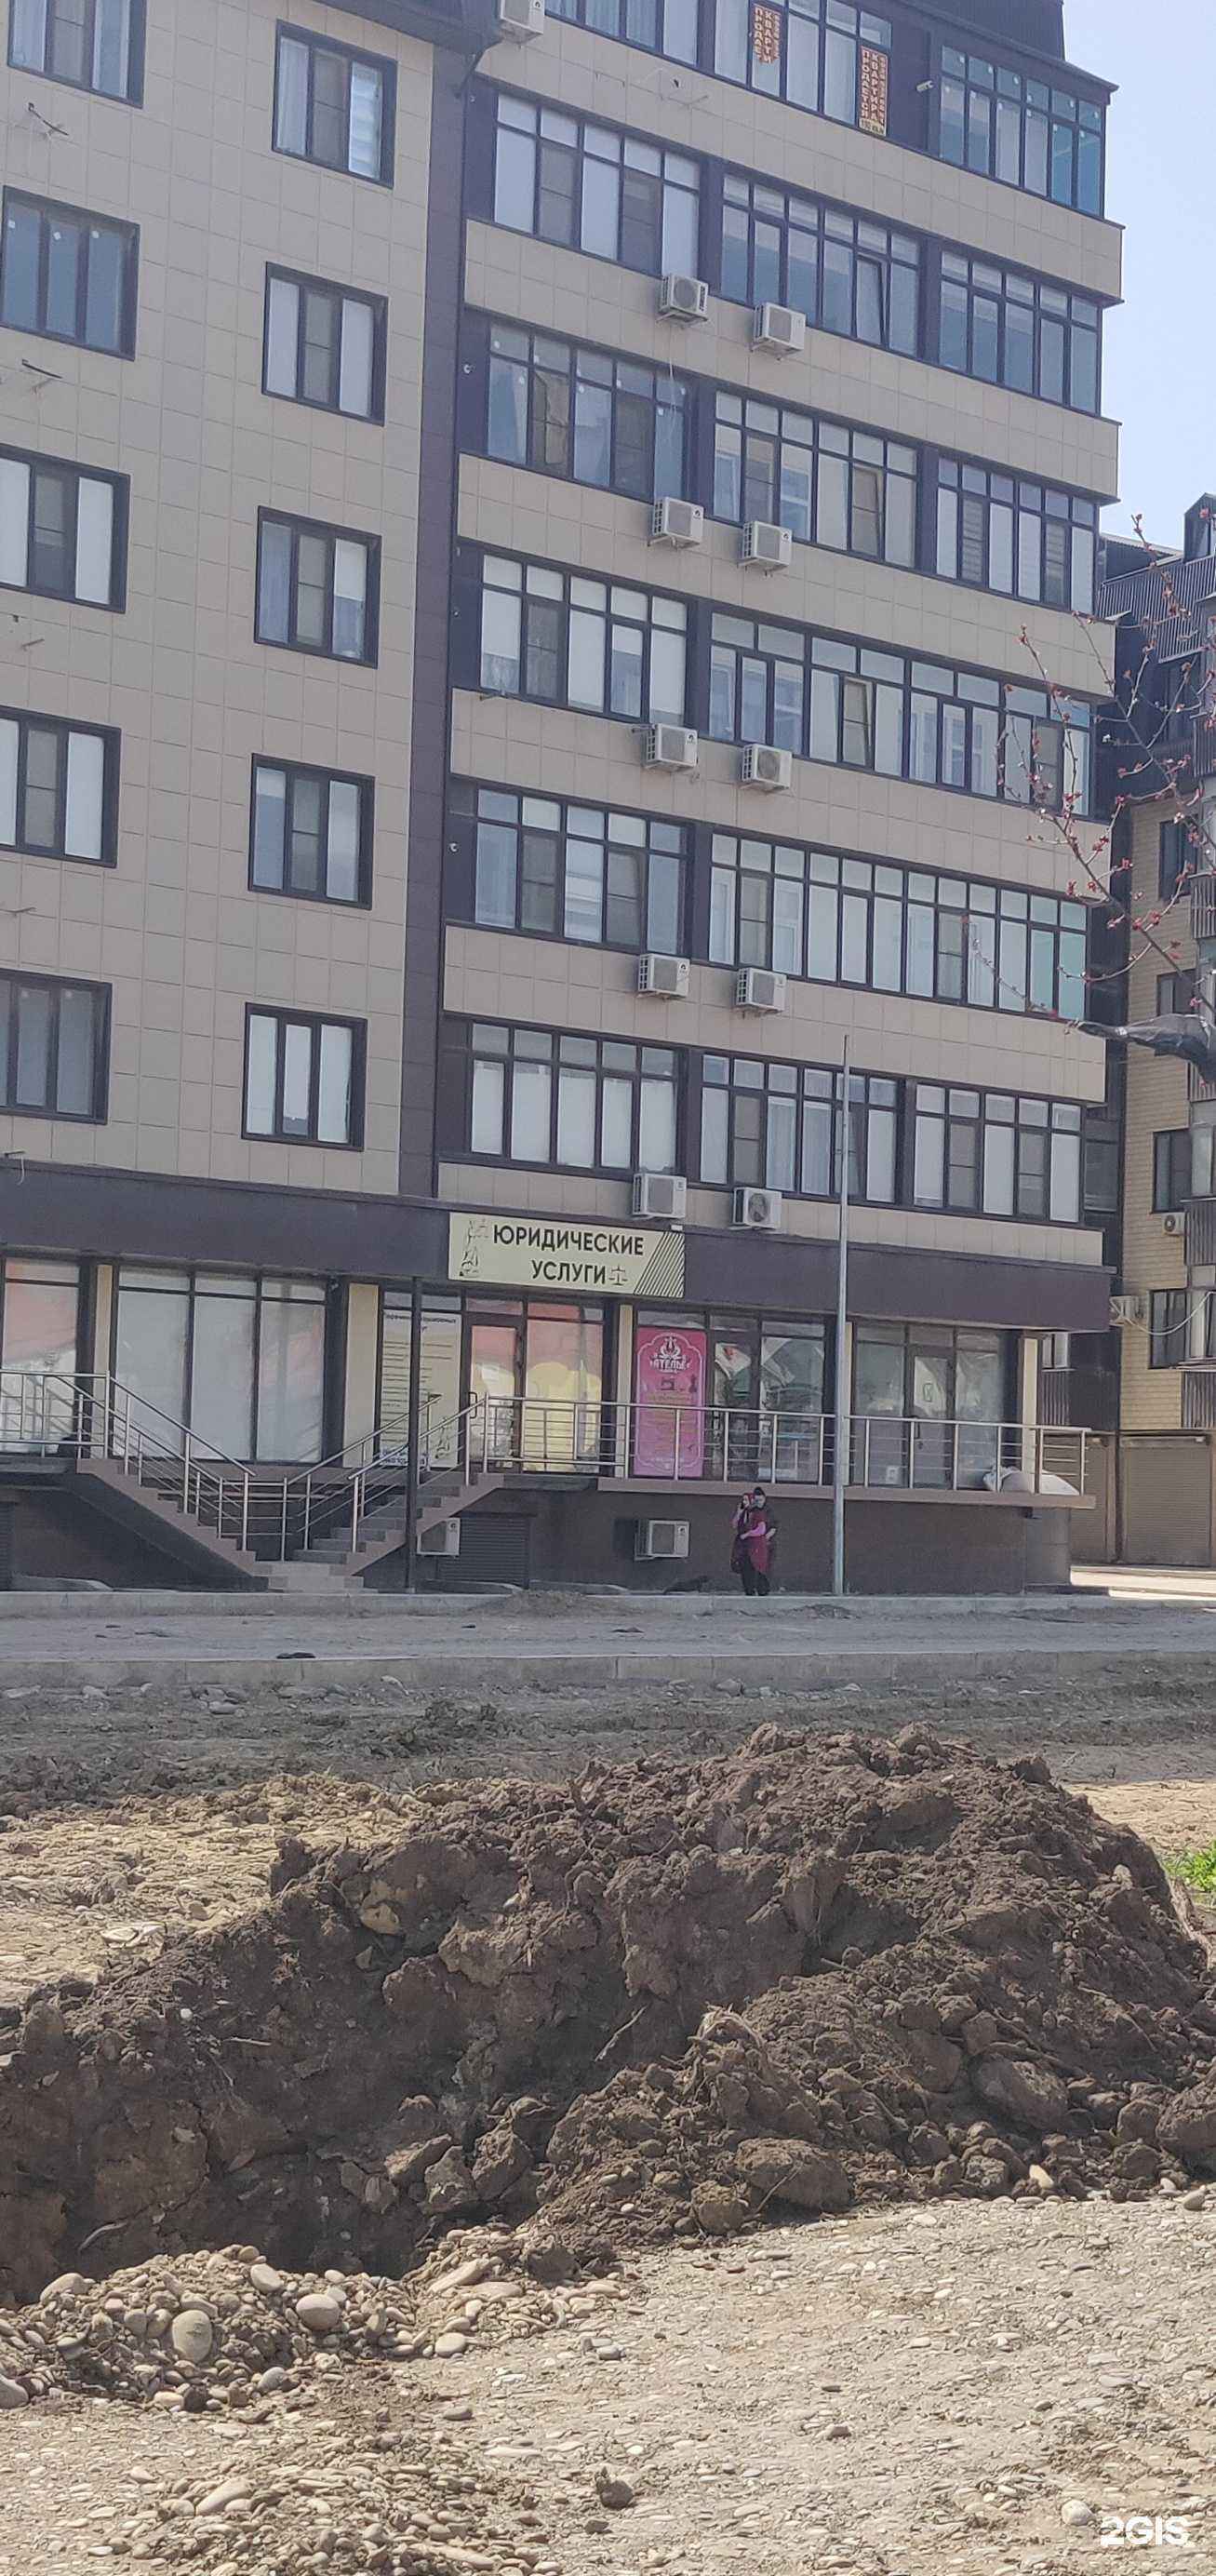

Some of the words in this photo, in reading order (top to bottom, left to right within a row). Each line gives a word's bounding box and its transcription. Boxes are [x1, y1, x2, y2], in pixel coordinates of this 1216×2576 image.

[862, 49, 870, 118] ПРОДАЕТСЯ
[871, 53, 879, 120] КВАРТИРА
[494, 1223, 644, 1255] ЮРИДИЧЕСКИЕ
[531, 1259, 607, 1285] УСЛУГИ
